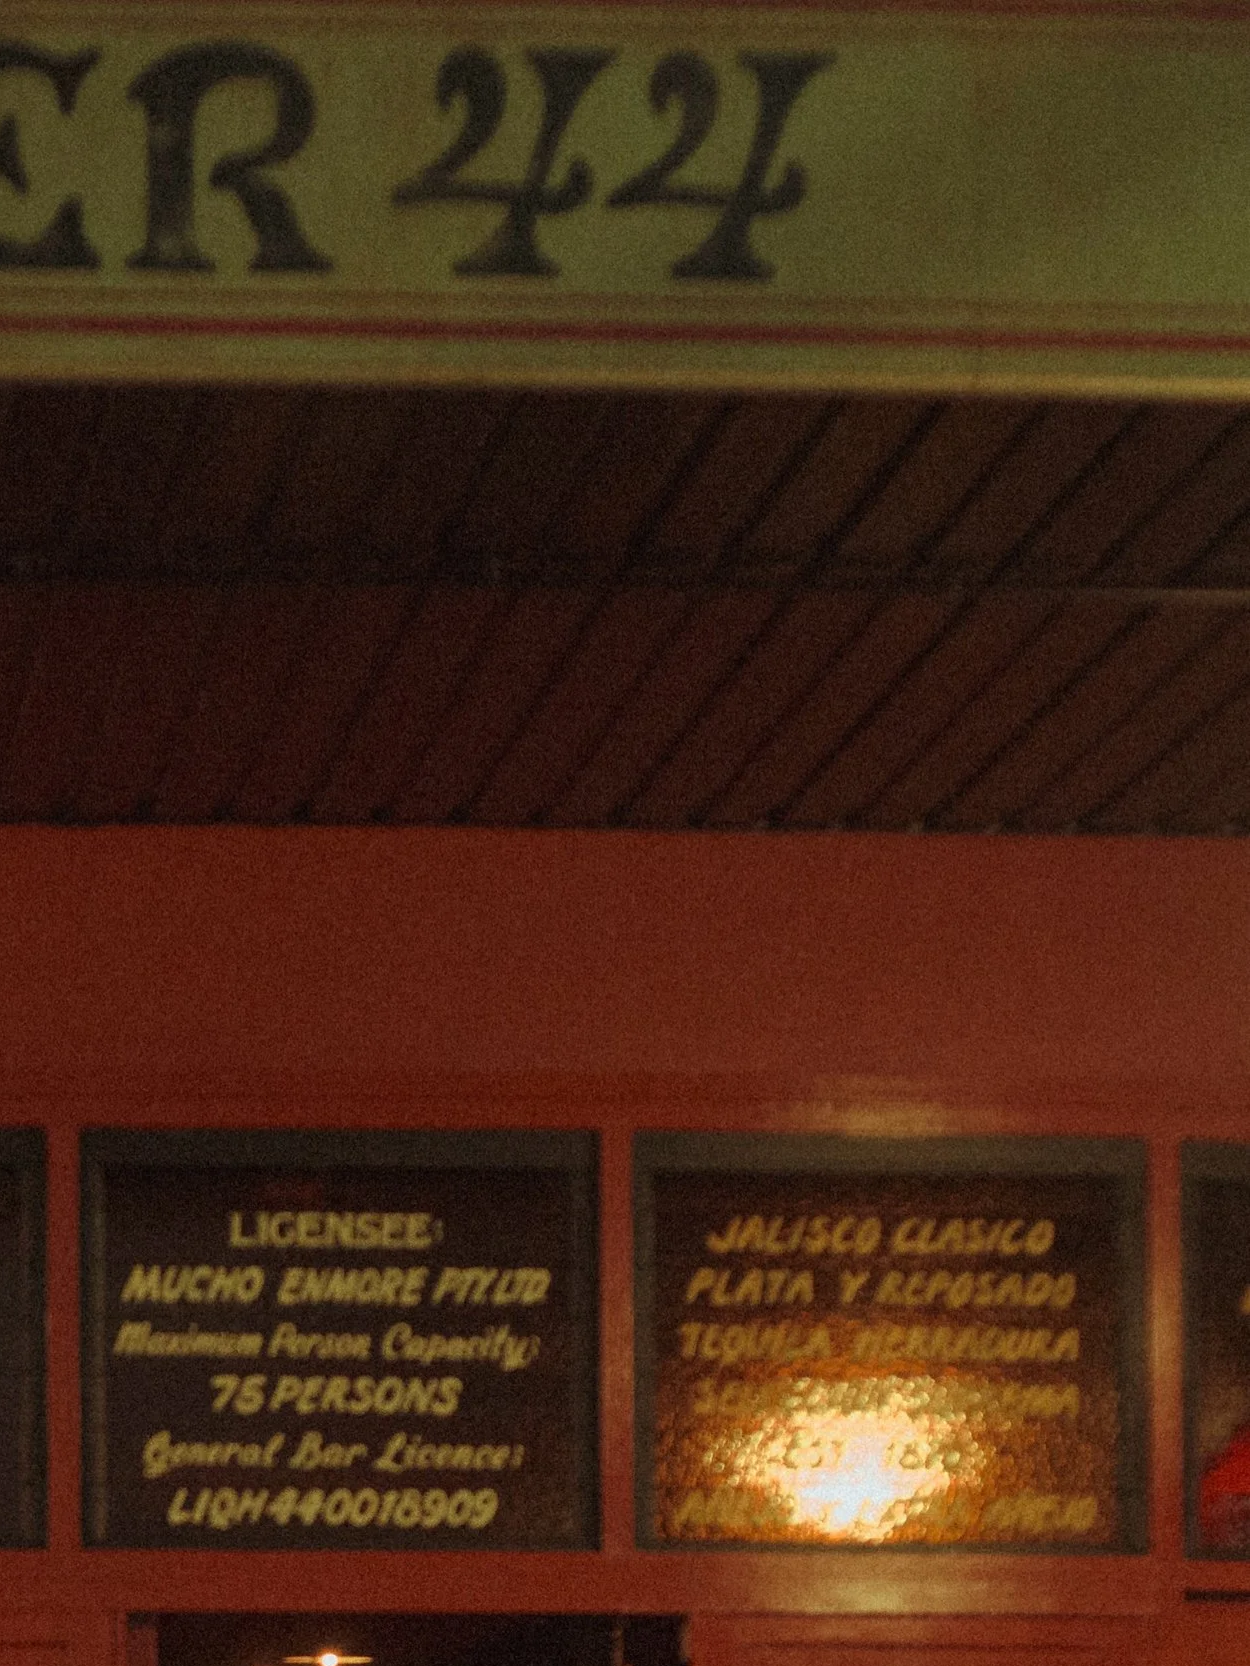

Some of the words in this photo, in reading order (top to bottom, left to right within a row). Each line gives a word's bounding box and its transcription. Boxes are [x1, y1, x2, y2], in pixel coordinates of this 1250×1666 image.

[390, 46, 838, 282] 44
[706, 1215, 884, 1256] JALISCO
[891, 1218, 1056, 1256] CLASICO
[120, 1264, 265, 1304] MUCHO
[276, 1265, 428, 1306] ENMORE
[686, 1267, 815, 1307] PLATA
[839, 1270, 867, 1305] Y
[877, 1270, 1077, 1309] REPOSADO
[113, 1320, 264, 1357] Maximum
[267, 1322, 371, 1360] Person
[679, 1320, 832, 1364] TEQUILA
[850, 1324, 1080, 1362] HERRADURA
[209, 1374, 266, 1415] 75
[269, 1374, 464, 1417] PERSONS
[142, 1430, 286, 1479] General
[289, 1430, 369, 1470] Bar
